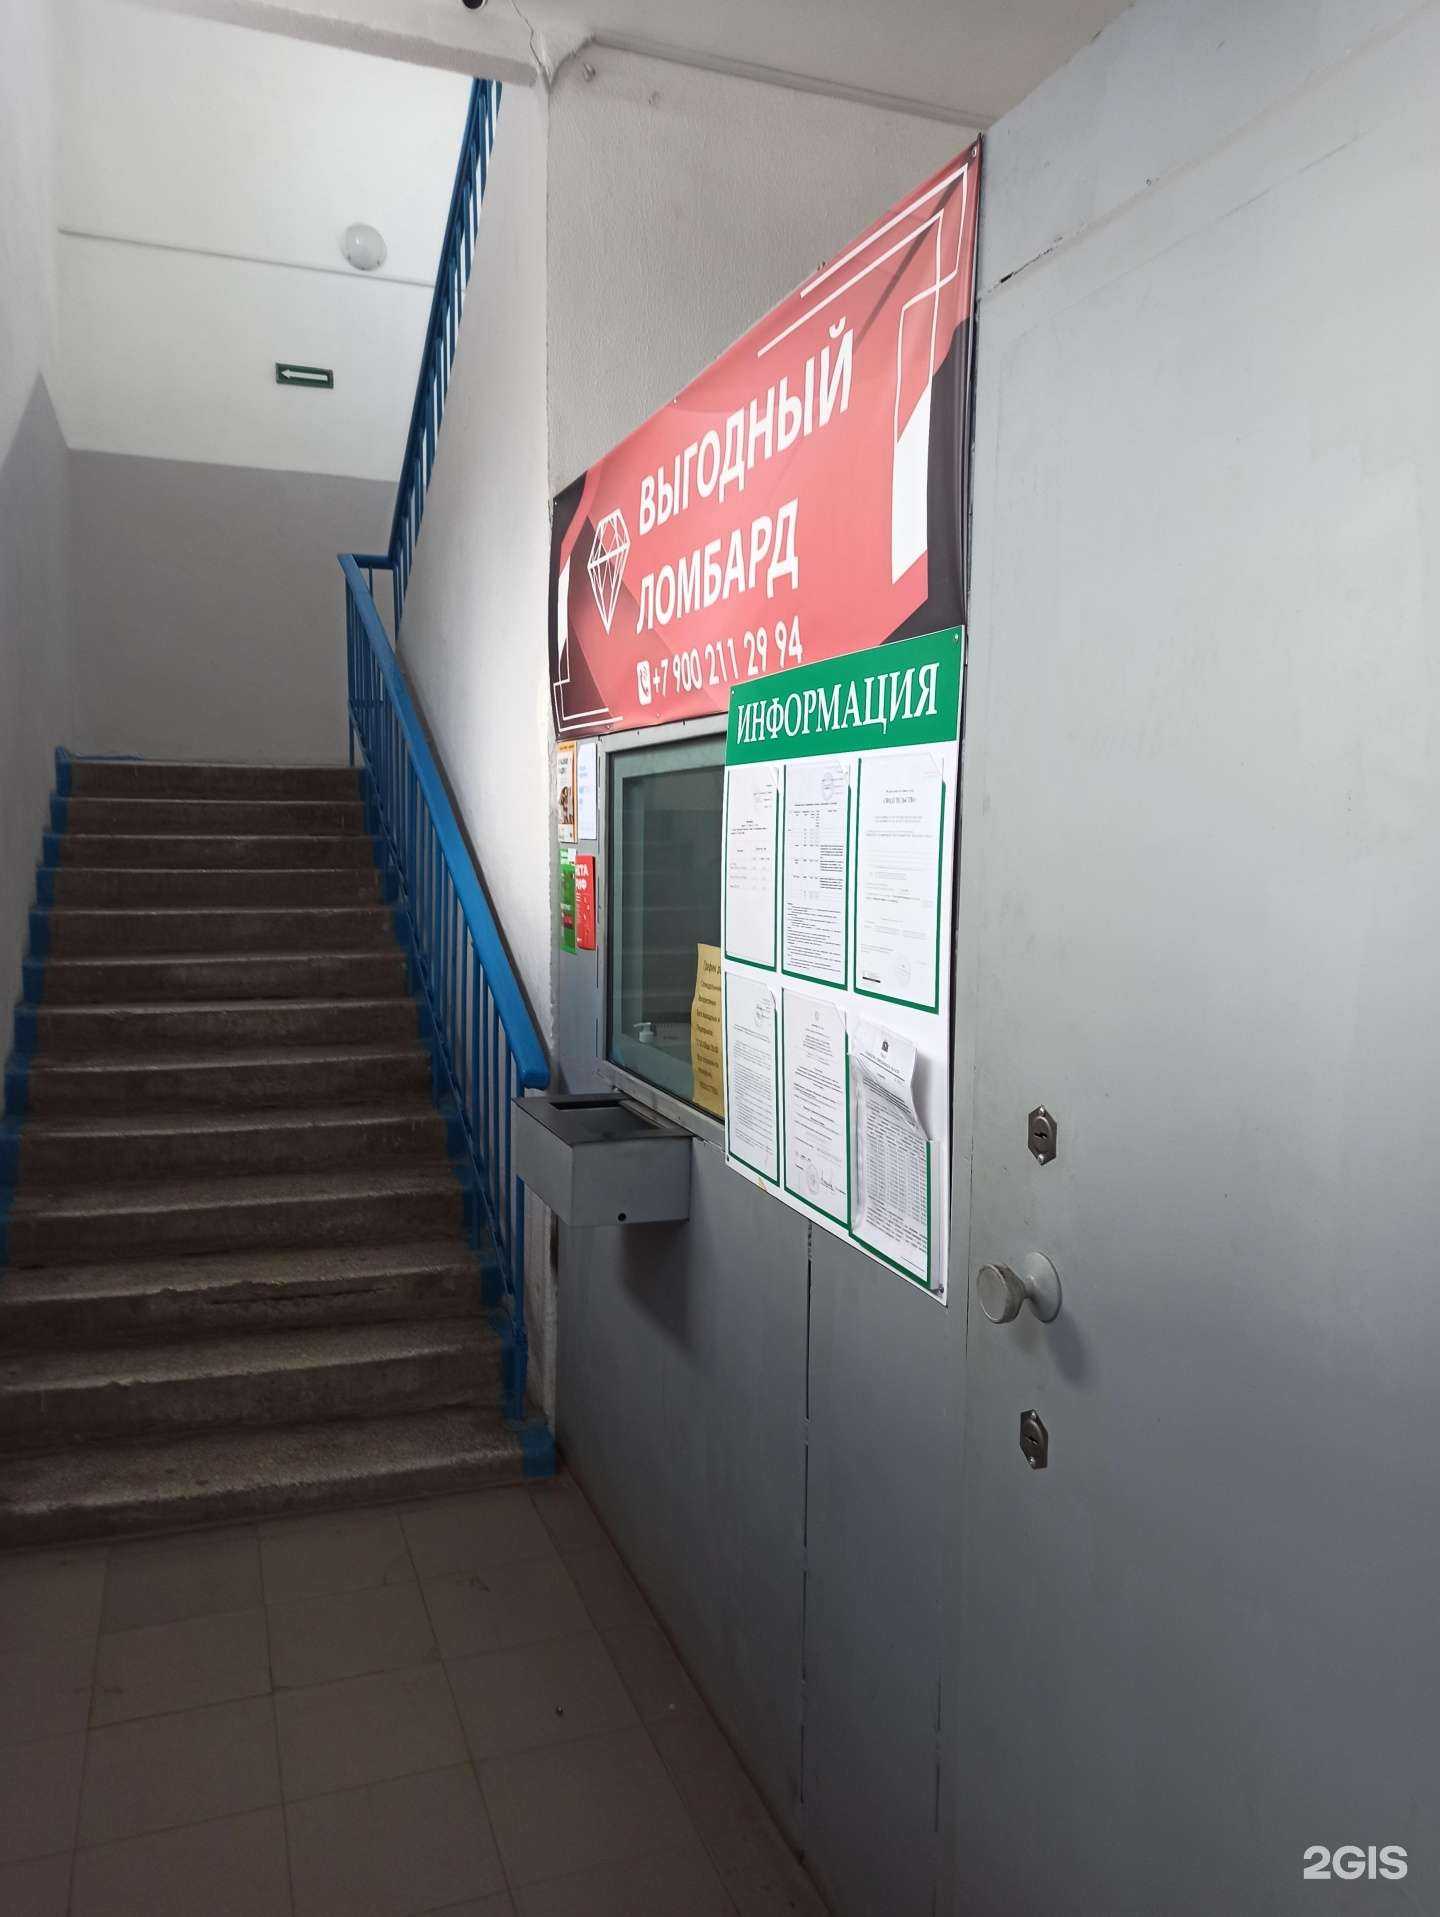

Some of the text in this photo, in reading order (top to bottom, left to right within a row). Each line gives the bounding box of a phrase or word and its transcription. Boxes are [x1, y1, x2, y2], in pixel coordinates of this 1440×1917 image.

[639, 316, 854, 536] ВЫГОДНЫЙ
[635, 497, 799, 634] ЛОМБАРД
[652, 615, 803, 697] +7 900 211 29 94
[736, 662, 940, 744] ИНФОРМАЦИЯ
